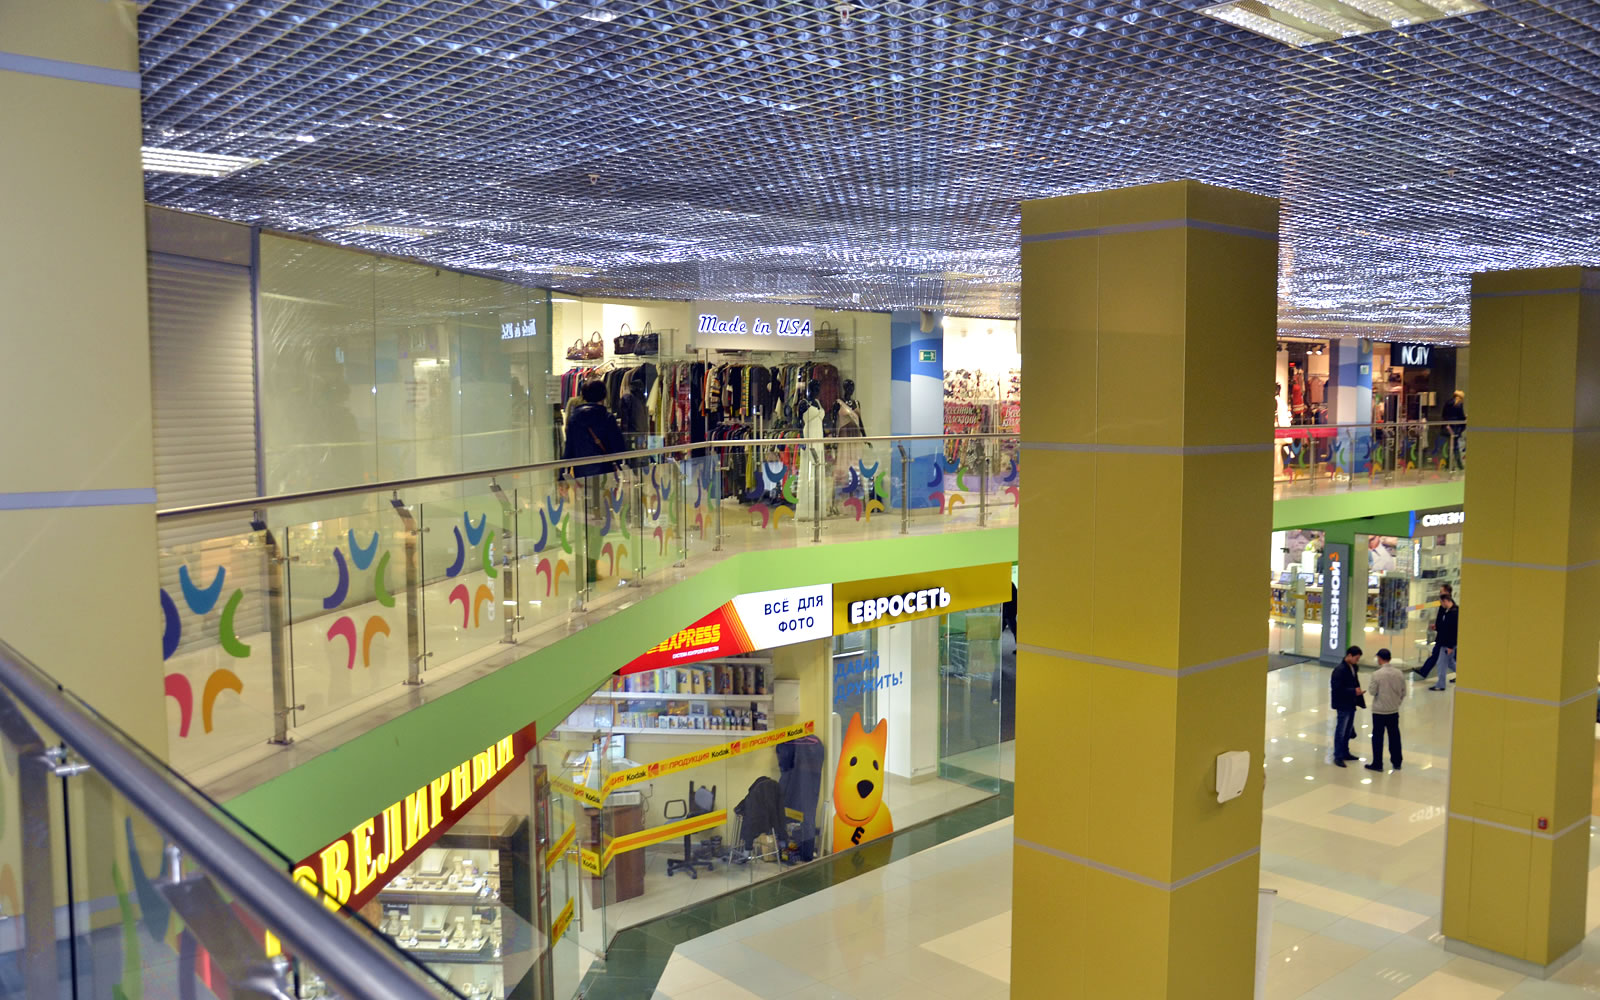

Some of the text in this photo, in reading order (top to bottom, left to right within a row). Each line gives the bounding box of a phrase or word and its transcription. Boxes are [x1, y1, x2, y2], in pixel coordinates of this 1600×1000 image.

[698, 314, 812, 336] Made in USA
[764, 595, 824, 615] ВСЁ ДЛЯ
[849, 587, 951, 624] ЕВРОСЕТЬ
[1329, 561, 1341, 650] СВЯЗНОЙ
[778, 616, 814, 632] ФОТО
[834, 650, 880, 683] ДАВАЙ
[834, 671, 903, 704] ДРУЖИТЬ!
[711, 747, 730, 759] Kodak
[787, 728, 803, 737] Kodak
[626, 769, 647, 781] Kodak
